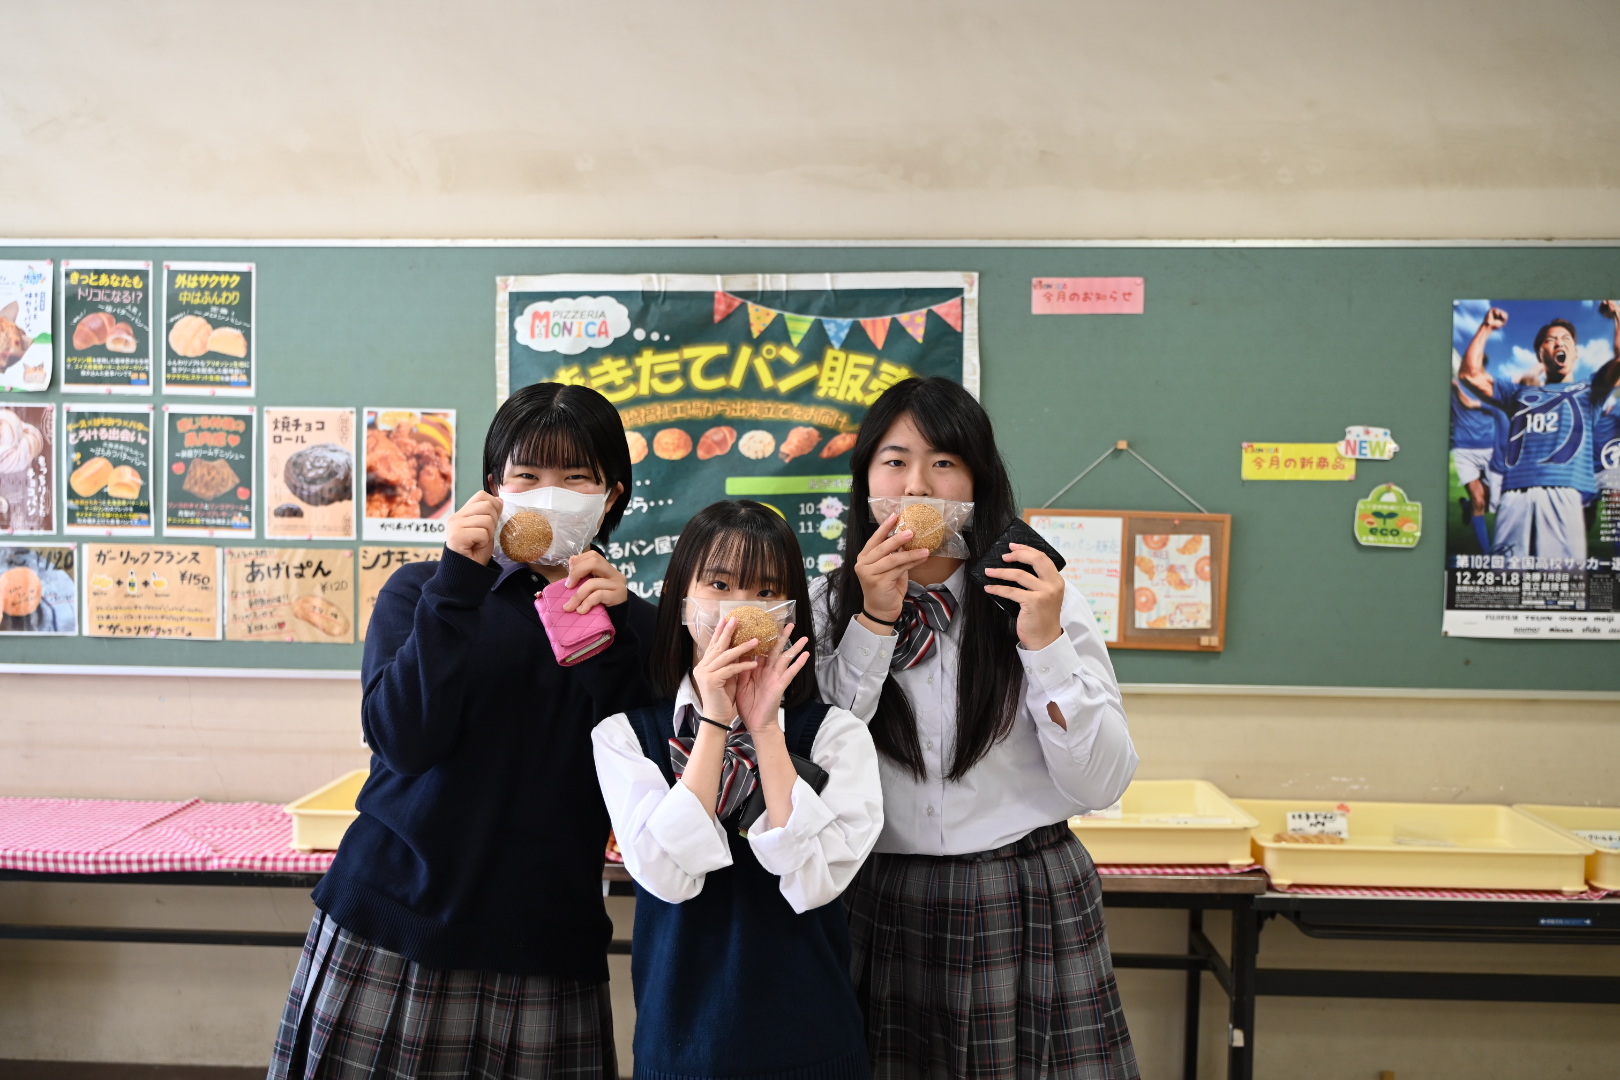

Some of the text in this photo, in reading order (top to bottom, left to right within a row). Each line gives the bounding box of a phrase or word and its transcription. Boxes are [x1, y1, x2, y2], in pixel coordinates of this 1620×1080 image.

[69, 272, 143, 288] きっとあなたも
[175, 274, 241, 289] 外はサクサク
[178, 291, 241, 305] 中はふんわり
[1043, 290, 1133, 303] 今月のお知らせ
[552, 310, 607, 320] PIZZERIA
[530, 310, 610, 339] MONICA
[1526, 412, 1559, 433] 102
[273, 434, 306, 444] ロール
[1345, 440, 1388, 456] NEW
[1252, 456, 1345, 470] 今月の新商品
[1368, 528, 1400, 537] eco
[1041, 534, 1120, 554] 月のパン販売
[95, 549, 201, 566] ガーリックフランス
[1455, 554, 1505, 569] 第102回
[180, 571, 211, 586] ¥150
[245, 559, 332, 583] あげぱん
[1455, 571, 1520, 586] 12.28-1.8
